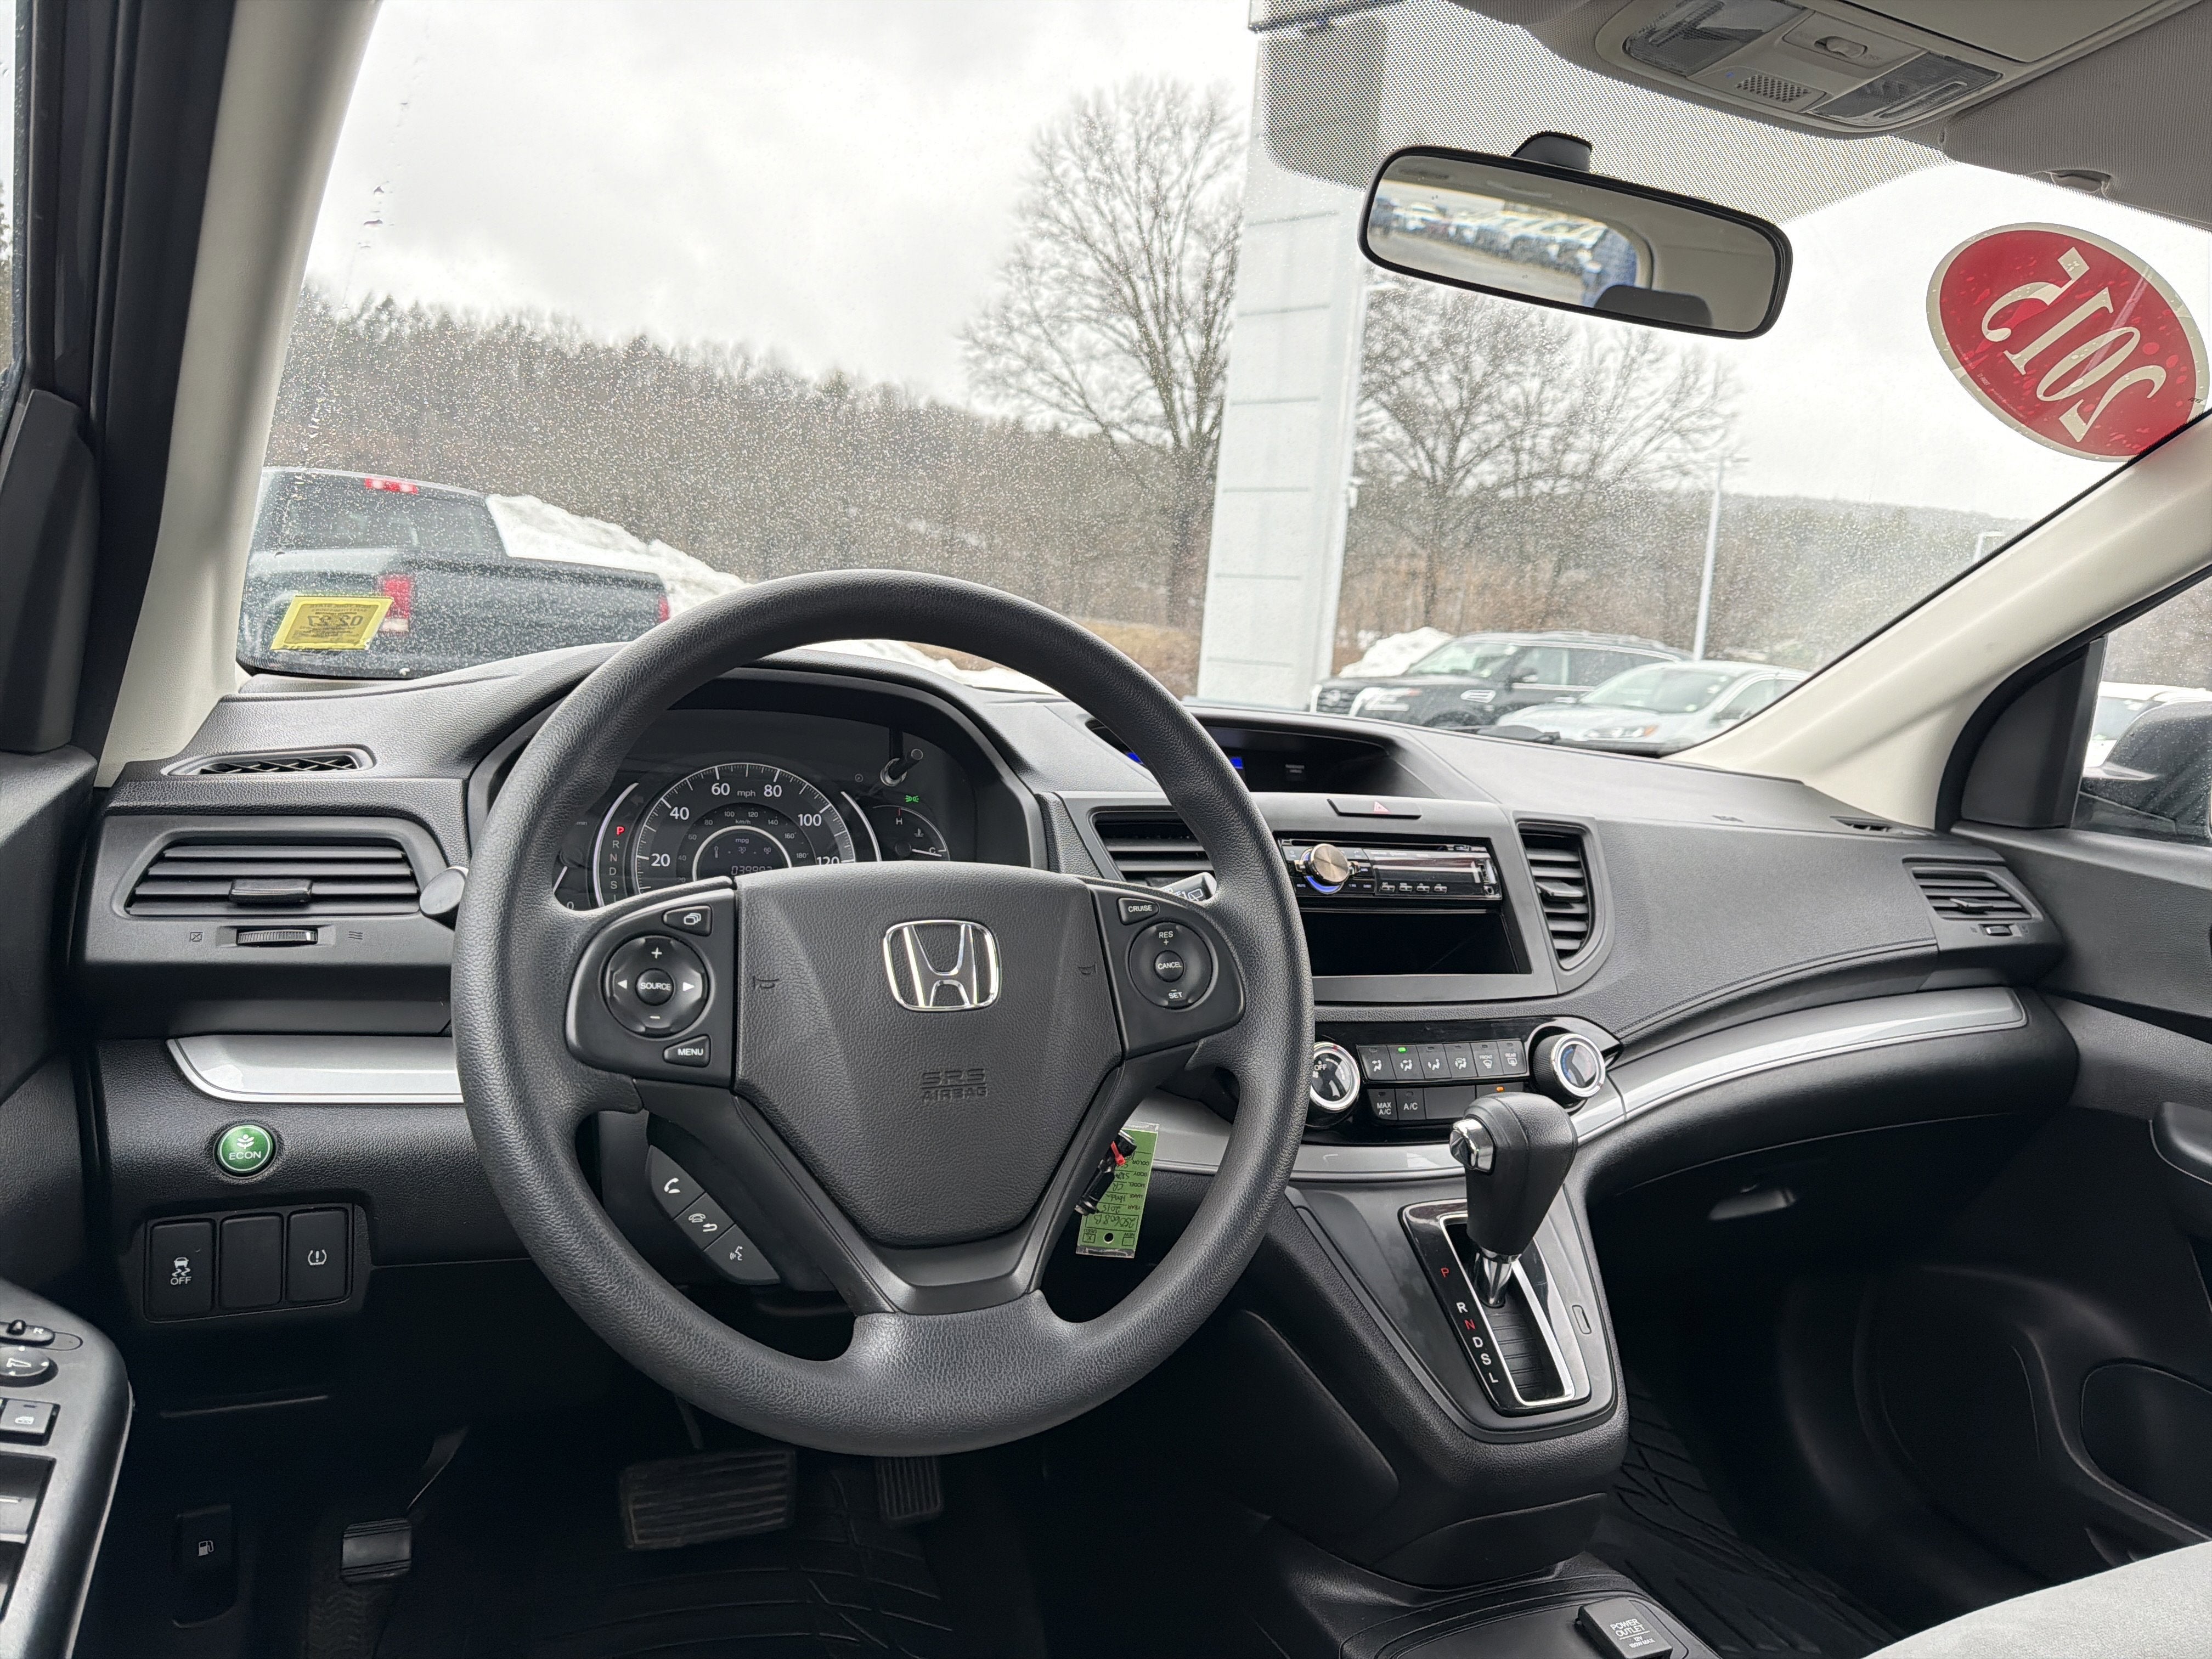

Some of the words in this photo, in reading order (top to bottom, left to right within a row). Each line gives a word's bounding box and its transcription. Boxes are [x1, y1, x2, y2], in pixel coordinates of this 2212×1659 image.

[712, 783, 730, 795] 60
[764, 785, 782, 797] 80
[670, 807, 689, 820] 40
[798, 814, 822, 827] 100
[616, 826, 625, 835] P
[612, 840, 619, 848] R
[610, 854, 617, 862] N
[651, 854, 670, 867] 20
[816, 856, 840, 865] 120
[609, 867, 617, 876] D
[611, 881, 618, 889] S
[1128, 905, 1153, 913] CRUISE
[1159, 930, 1173, 939] RES
[1157, 961, 1182, 970] CANCEL
[640, 981, 672, 991] SOURCE
[678, 1048, 704, 1057] MENU
[922, 1068, 985, 1085] SRS
[922, 1087, 988, 1102] AIRBAG
[1403, 1102, 1418, 1110] A/C
[229, 1150, 262, 1161] ECON
[1102, 1204, 1121, 1214] 2015
[1440, 1267, 1449, 1278] P
[170, 1276, 192, 1285] OFF
[1456, 1301, 1468, 1313] R
[1464, 1318, 1476, 1330] N
[1472, 1336, 1483, 1348] D
[1481, 1353, 1492, 1365] S
[1488, 1372, 1499, 1384] L
[1610, 1618, 1640, 1631] POWER
[1615, 1624, 1645, 1637] OUTLET
